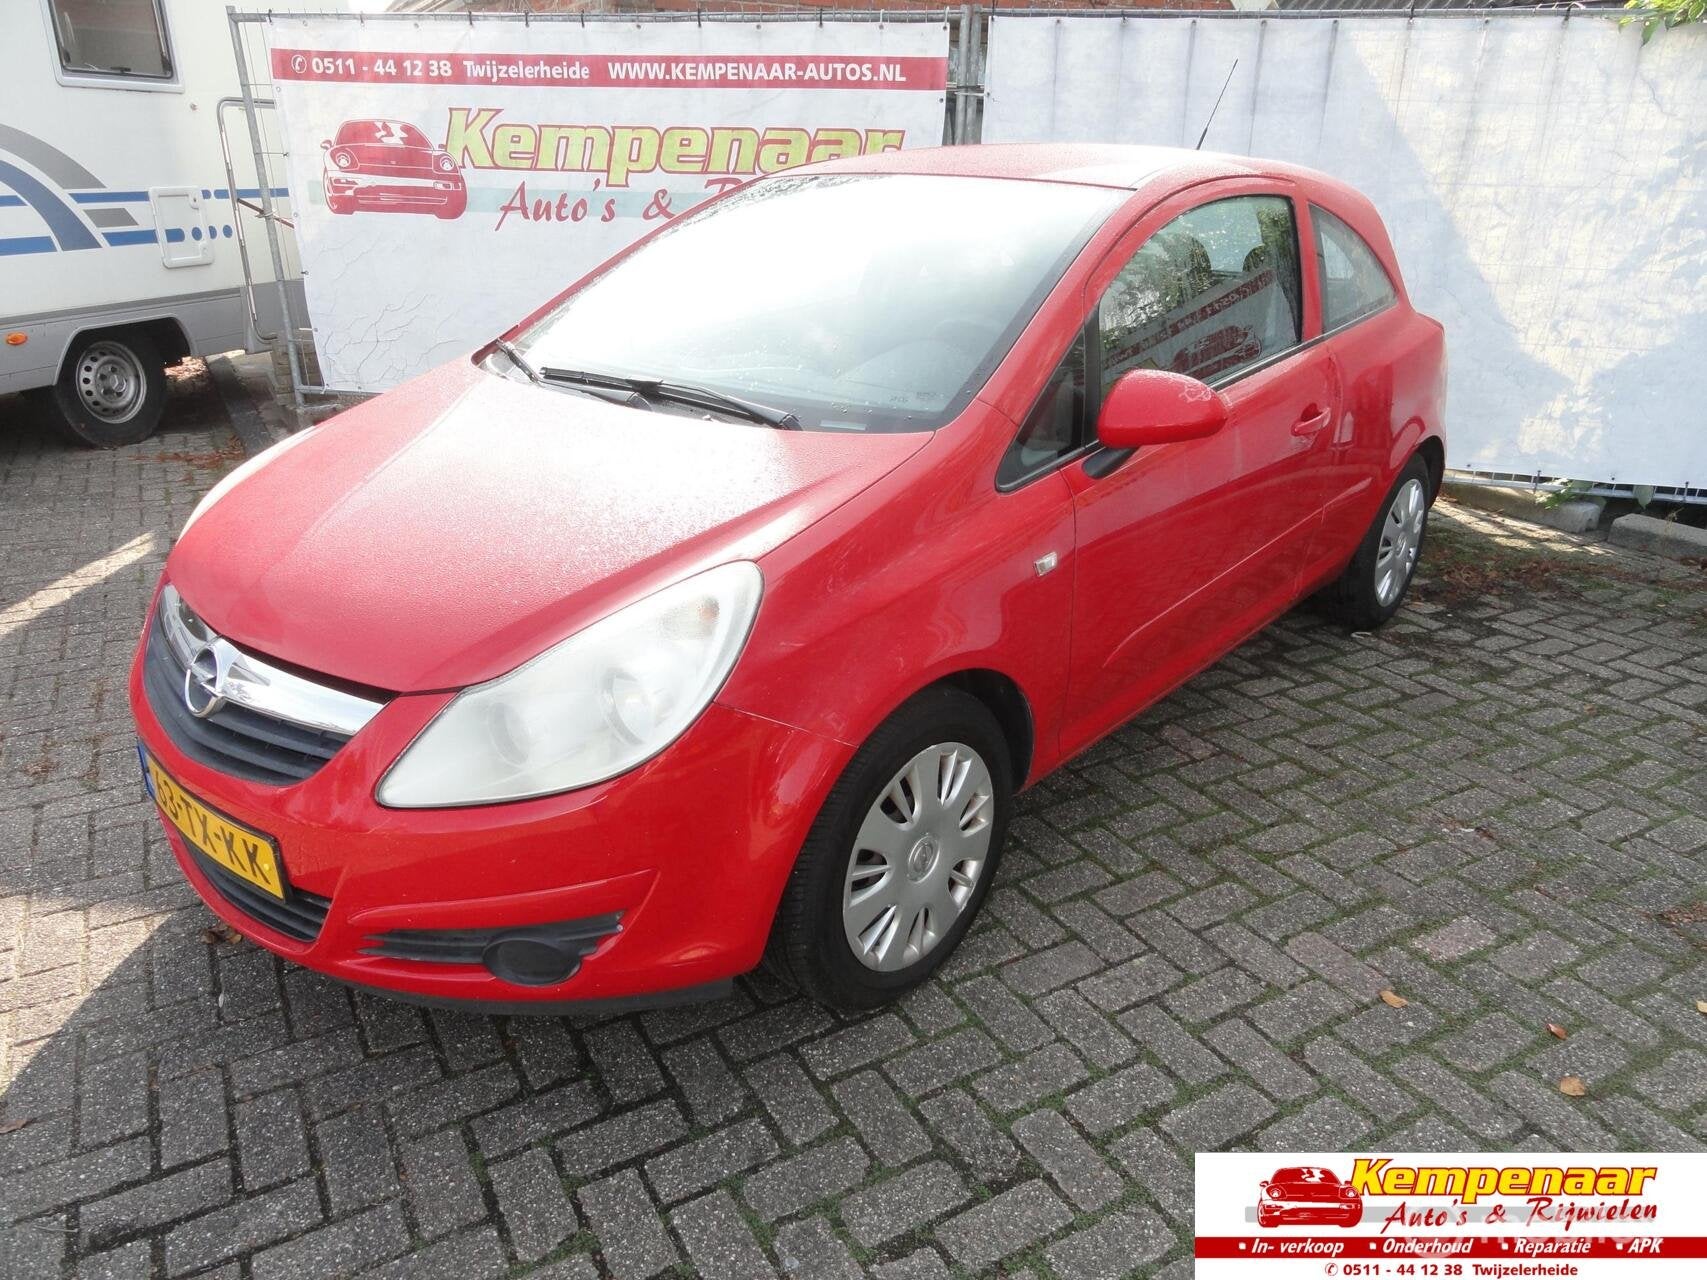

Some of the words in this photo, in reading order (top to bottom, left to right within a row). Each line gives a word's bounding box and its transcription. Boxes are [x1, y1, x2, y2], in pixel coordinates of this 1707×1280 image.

[312, 57, 356, 75] 0511
[373, 58, 397, 75] 44
[403, 59, 423, 76] 12
[428, 60, 453, 77] 38
[463, 60, 590, 82] Twijzelerheide
[608, 62, 906, 82] WWW.KEMPENAAR-AUTOS.NL
[445, 107, 906, 188] Kempenaar
[495, 176, 616, 232] Auto's
[642, 188, 677, 221] &
